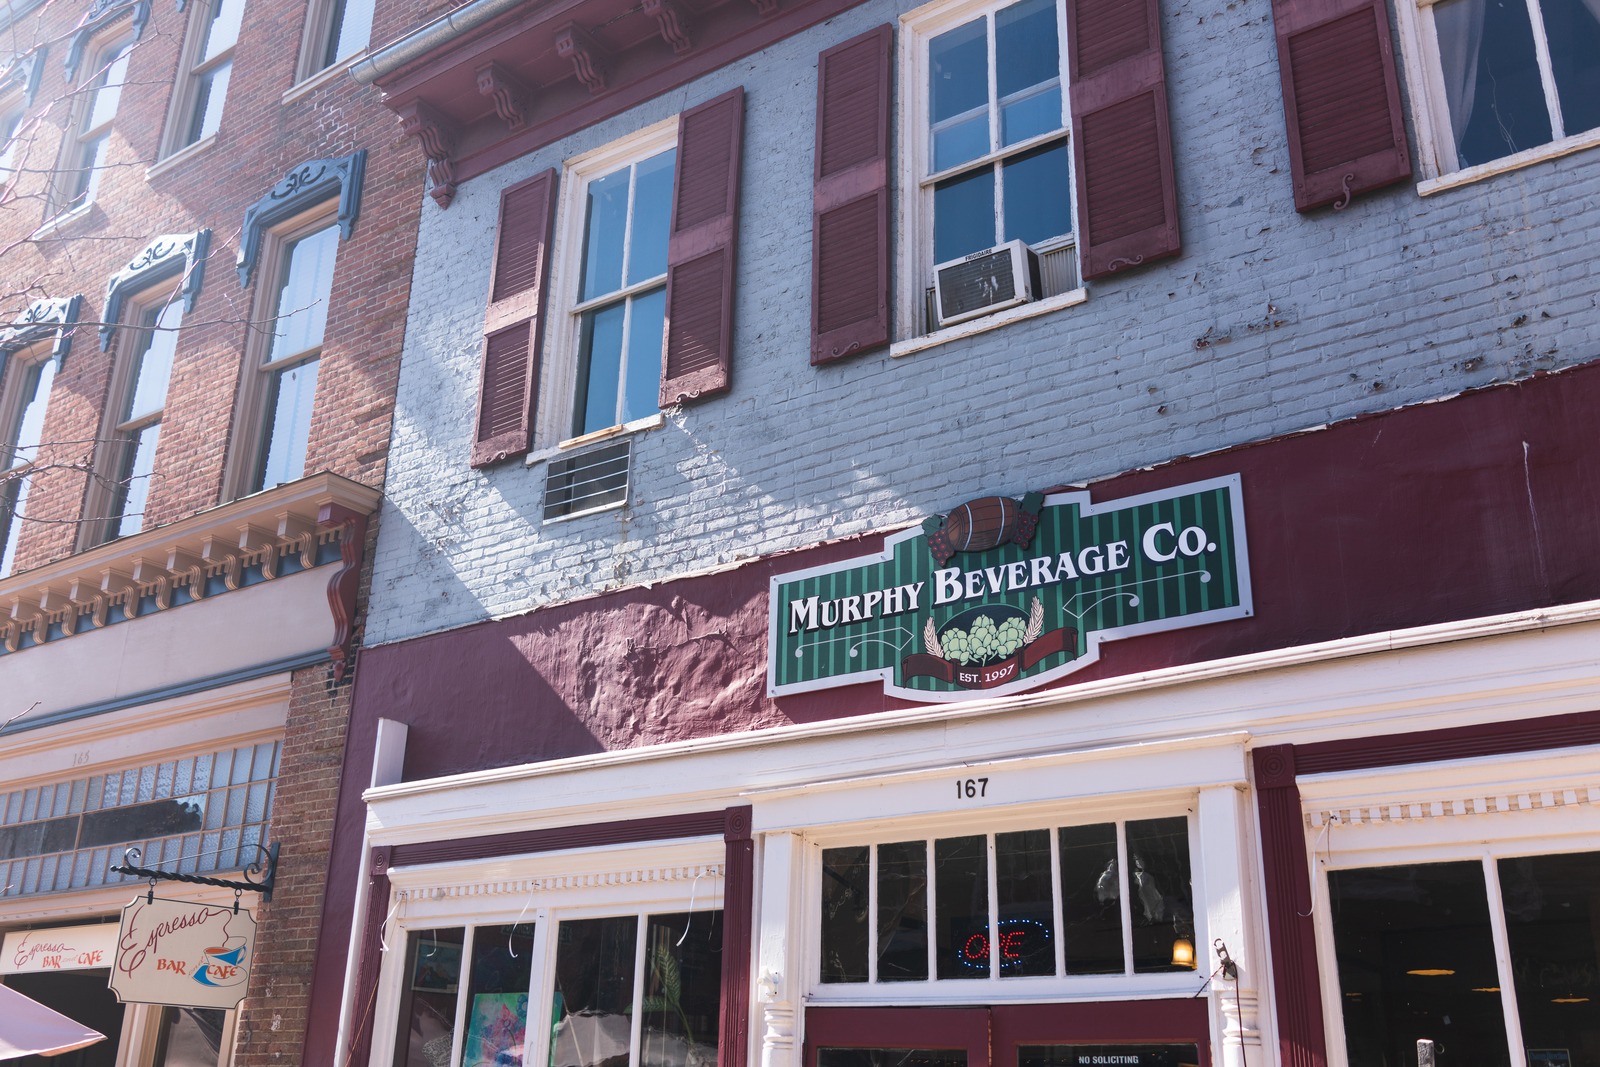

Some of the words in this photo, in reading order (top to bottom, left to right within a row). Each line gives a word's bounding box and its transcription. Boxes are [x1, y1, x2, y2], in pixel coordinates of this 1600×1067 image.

[965, 248, 992, 261] FRIGIDAIRE
[789, 581, 925, 633] MURPHY
[934, 540, 1130, 605] BEVERAGE
[959, 672, 981, 683] EST.
[985, 663, 1015, 682] 1997
[72, 749, 90, 767] 165
[956, 777, 989, 799] 167
[14, 931, 76, 970] Espresso
[119, 903, 212, 979] Espresso
[42, 954, 62, 969] BAR
[77, 949, 104, 966] CAFE
[156, 958, 186, 975] BAR
[206, 964, 238, 979] CAFE
[1078, 1055, 1090, 1064] NO
[1092, 1055, 1139, 1064] SOLICITING
